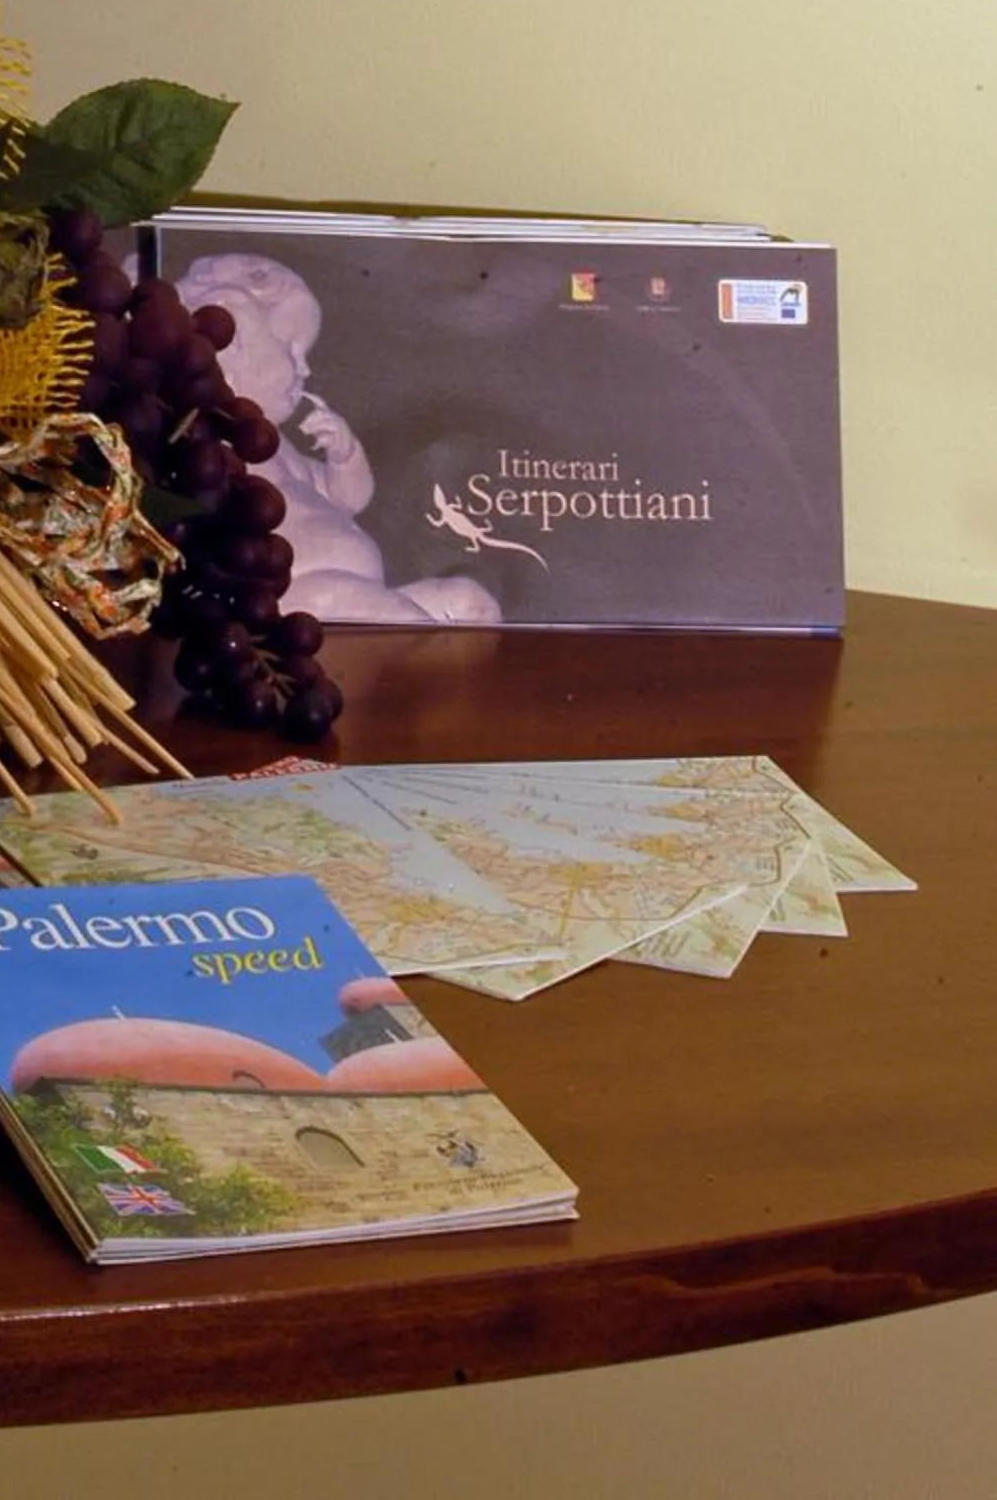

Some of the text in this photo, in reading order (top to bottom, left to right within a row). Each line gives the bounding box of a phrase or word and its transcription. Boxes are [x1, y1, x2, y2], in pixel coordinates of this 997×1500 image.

[497, 449, 620, 482] Itinerari
[467, 474, 714, 532] Serpottiani
[191, 937, 324, 986] speed
